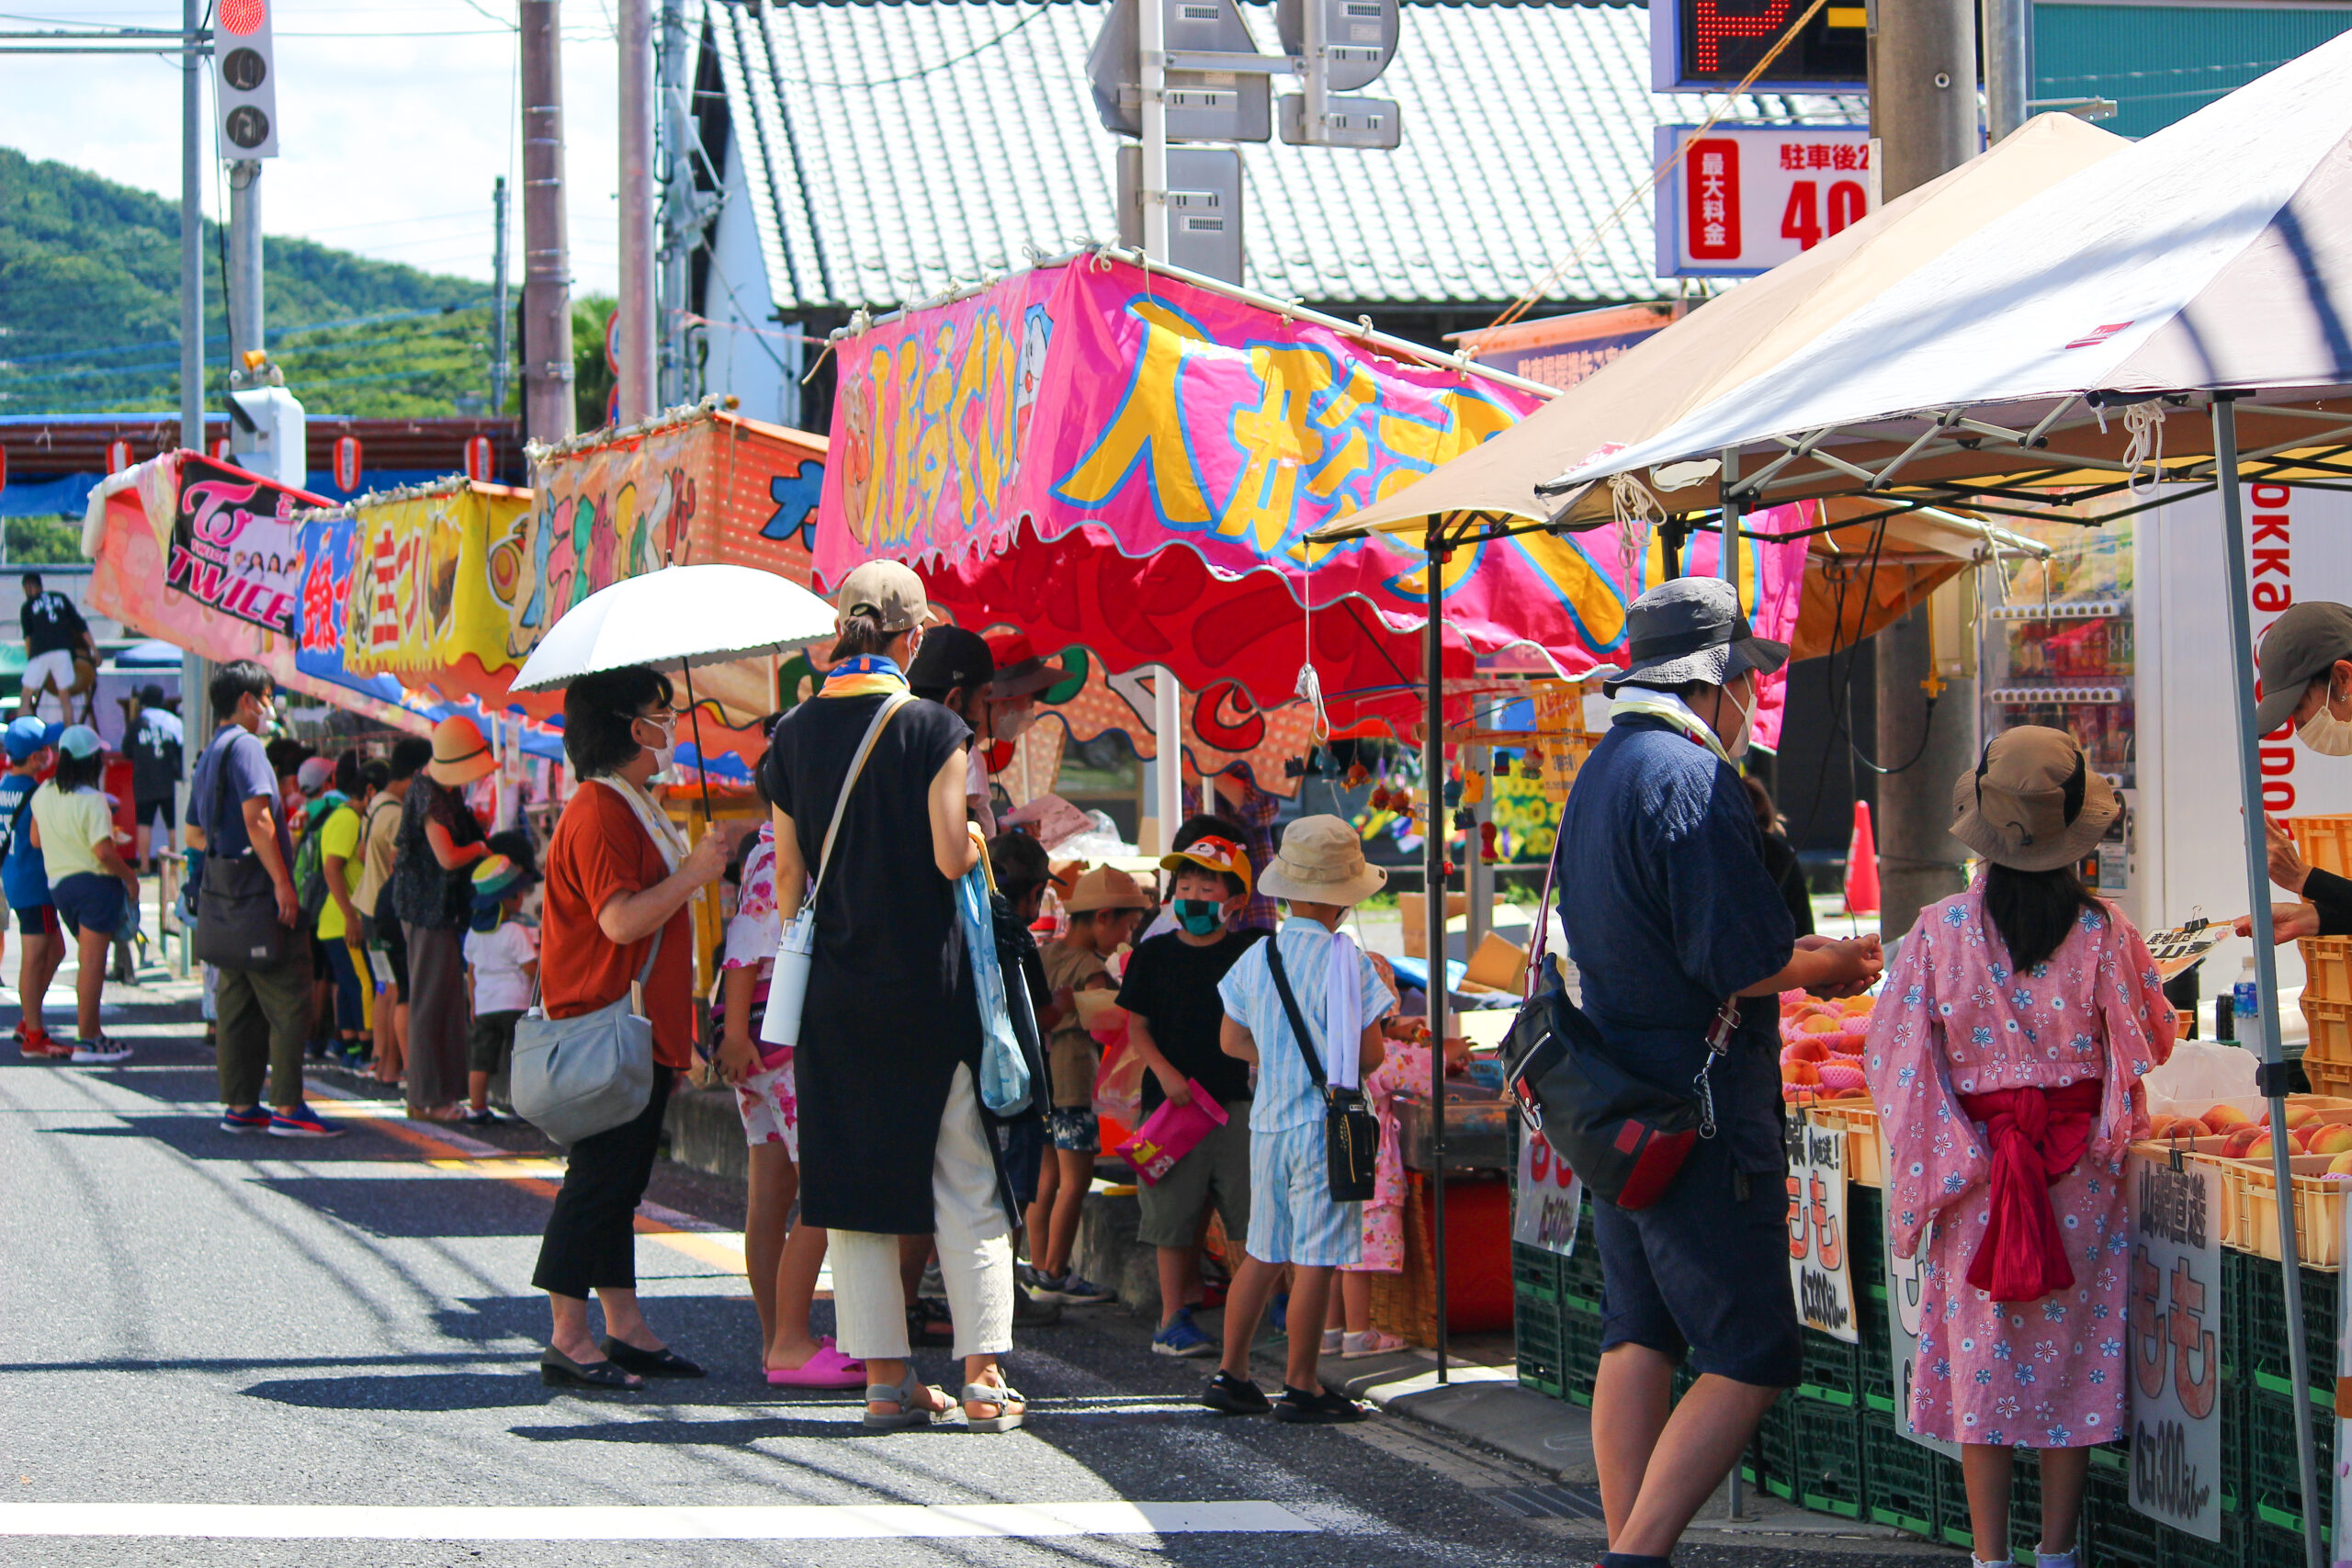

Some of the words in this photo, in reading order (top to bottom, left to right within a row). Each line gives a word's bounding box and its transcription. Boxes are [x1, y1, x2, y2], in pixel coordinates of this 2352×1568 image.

[1702, 152, 1725, 246] 最大料金
[1781, 180, 1867, 252] 40
[166, 543, 296, 628] TWICE
[2132, 1243, 2216, 1420] もも
